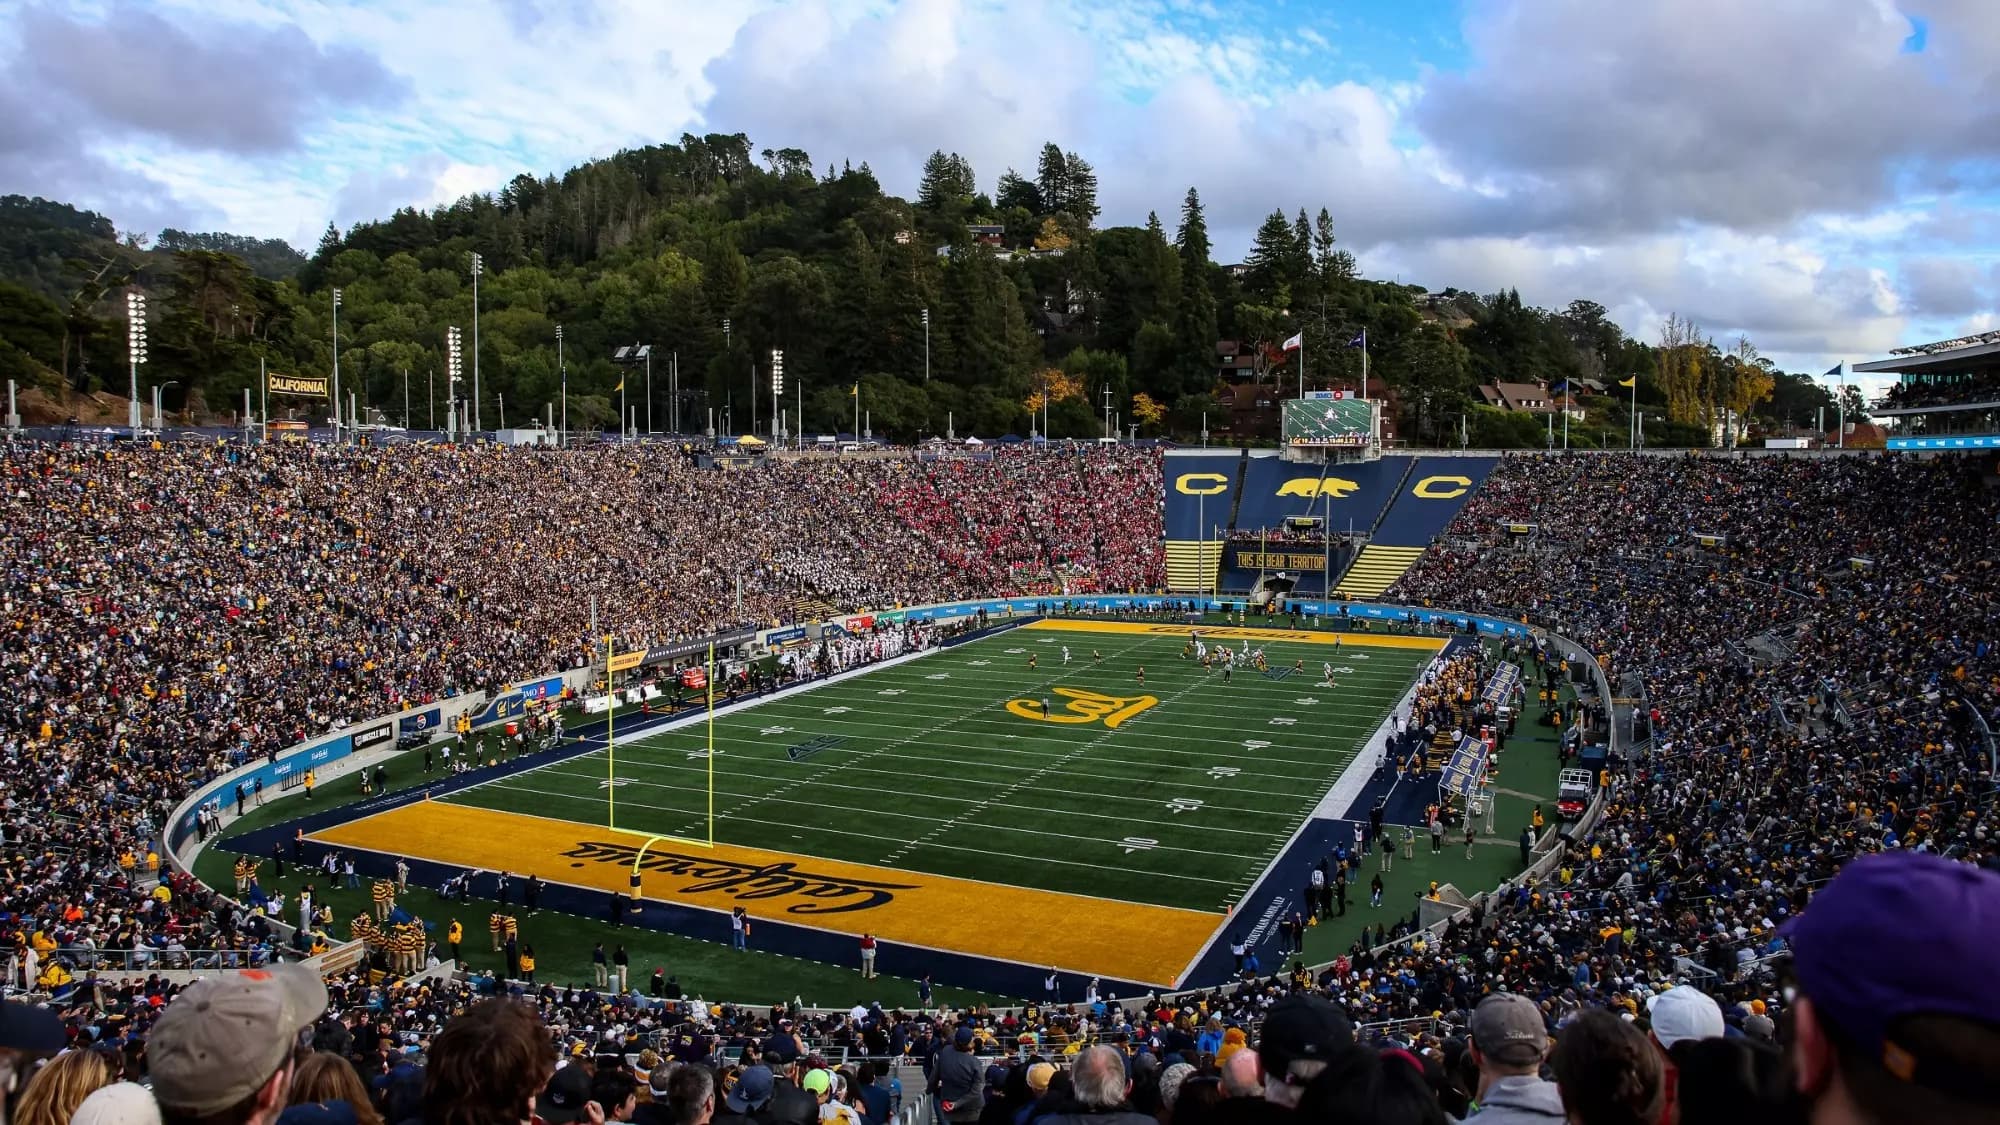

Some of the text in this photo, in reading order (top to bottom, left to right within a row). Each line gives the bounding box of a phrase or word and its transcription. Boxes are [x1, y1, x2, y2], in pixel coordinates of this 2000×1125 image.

[270, 377, 324, 392] CALIFORNIA
[1175, 473, 1228, 495] C
[1412, 476, 1472, 498] C
[1237, 554, 1254, 567] THIS
[1256, 555, 1264, 567] IS
[1266, 555, 1285, 567] BEAR
[1006, 688, 1158, 728] Cal
[560, 841, 924, 914] California
